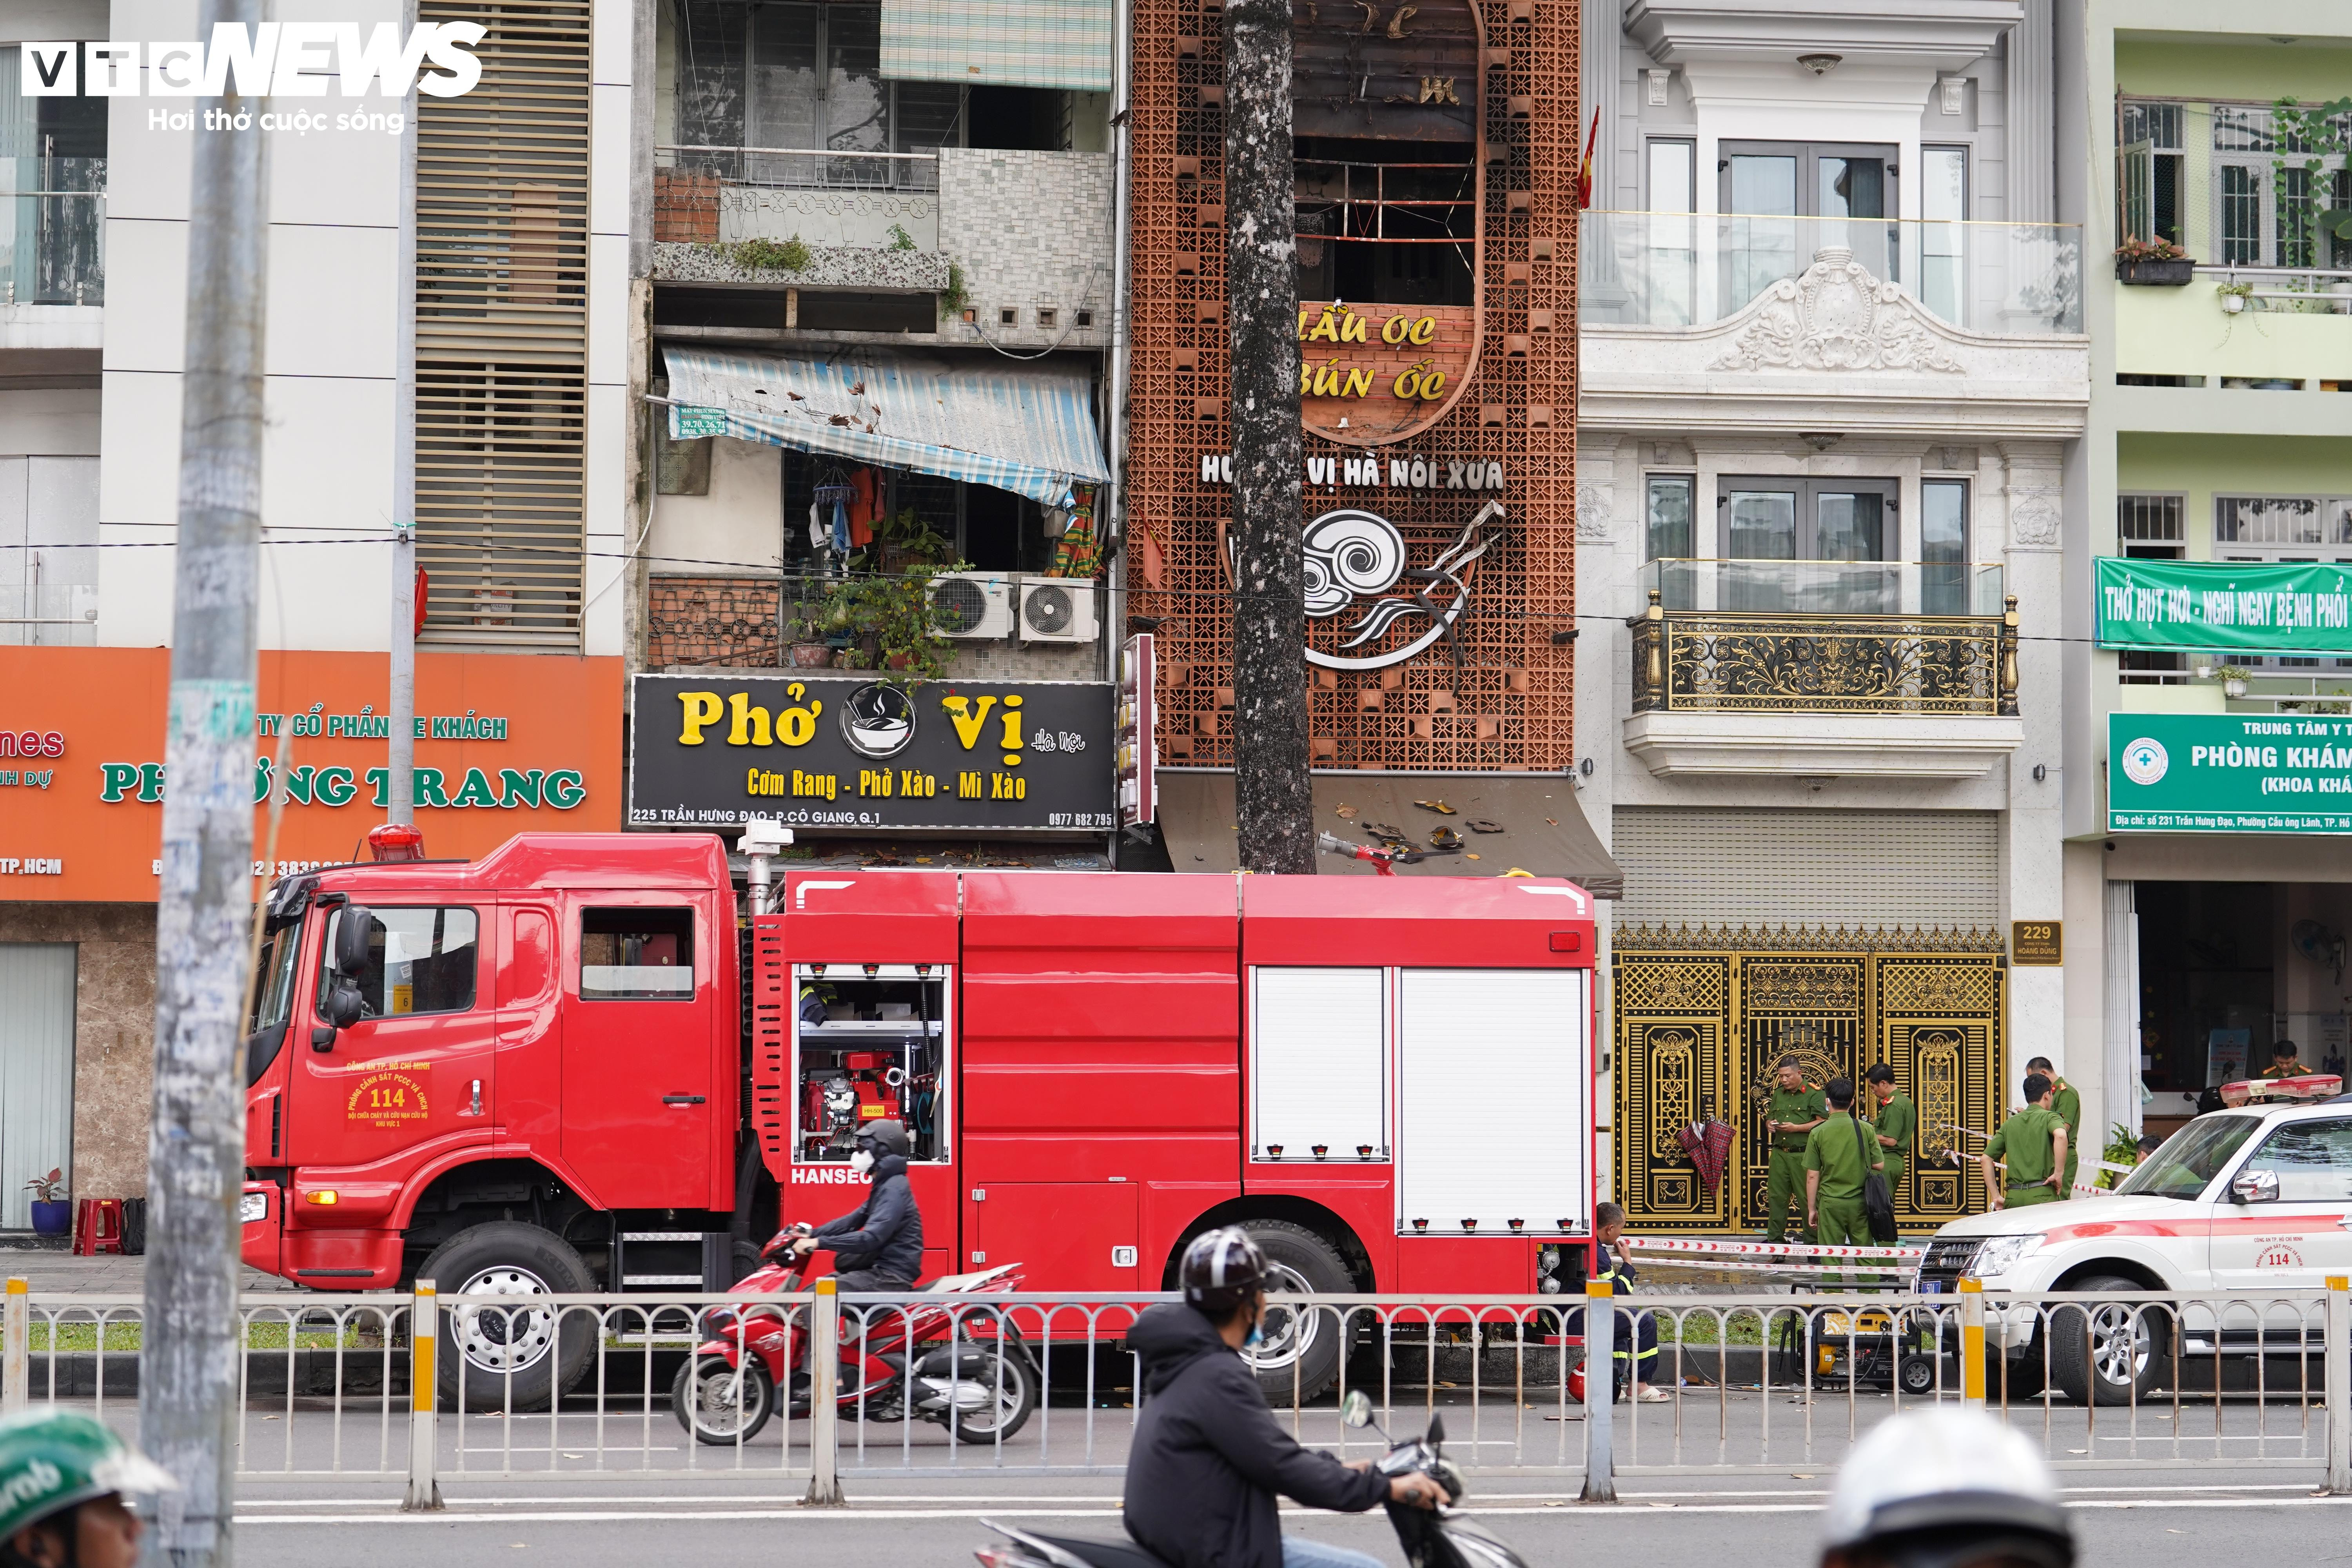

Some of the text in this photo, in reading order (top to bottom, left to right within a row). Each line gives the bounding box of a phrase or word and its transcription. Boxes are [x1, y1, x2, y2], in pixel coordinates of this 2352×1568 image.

[1301, 357, 1446, 401] BÚN ỐC
[1307, 457, 1335, 494] VỊ
[1344, 452, 1380, 487] HÀ
[1447, 456, 1504, 490] XƯA
[2105, 573, 2134, 622] THỞ
[2136, 588, 2164, 630] HỤT
[2168, 584, 2191, 623] HƠI
[2238, 592, 2272, 627] NGAY
[2276, 583, 2312, 634] BỆNH
[2316, 575, 2348, 628] PHỔI
[257, 701, 508, 740] TY CỔ PHẦN E KHÁCH
[677, 682, 1025, 767] Phở Vị
[2243, 720, 2342, 736] TRUNG TÂM Y
[1031, 728, 1086, 754] Hà Nội
[2192, 741, 2278, 768] PHÒNG
[24, 769, 54, 790] DỰ
[365, 767, 586, 810] TRANG
[747, 767, 784, 797] Cơm
[792, 769, 836, 801] Rang
[860, 767, 893, 798] Phở
[900, 769, 936, 798] Xào
[959, 771, 982, 799] Mì
[991, 772, 1026, 800] Xào
[2261, 777, 2314, 795] (KHOA
[633, 809, 657, 820] 225
[661, 804, 695, 821] TRẦN
[699, 809, 735, 822] HƯNG
[812, 811, 857, 824] GIANG,
[859, 812, 879, 824] Q.1
[1049, 813, 1112, 826] 0977 682 795
[2115, 814, 2350, 829] Địa chỉ: số 231 Trần Hưng Đạo, Phường Cầu ông Lãnh, TP. Hồ
[2023, 926, 2051, 939] 229
[2018, 946, 2057, 955] HOÀNG DŨNG
[347, 1060, 365, 1071] CÔNG
[366, 1062, 375, 1071] AN
[389, 1059, 399, 1070] HỒ
[400, 1061, 412, 1070] CHÍ
[413, 1062, 430, 1070] MINH
[348, 1071, 428, 1111] PHÒNG CẢNH SÁT PCCC VÀ CNCH
[370, 1088, 405, 1107] 114
[348, 1112, 356, 1120] ĐỘI
[357, 1111, 370, 1119] CHỮA
[370, 1111, 382, 1119] CHÁY
[421, 1111, 428, 1120] HỘ
[386, 1120, 395, 1128] VỰC
[2269, 1253, 2289, 1265] 114
[543, 1252, 578, 1292] KUMH
